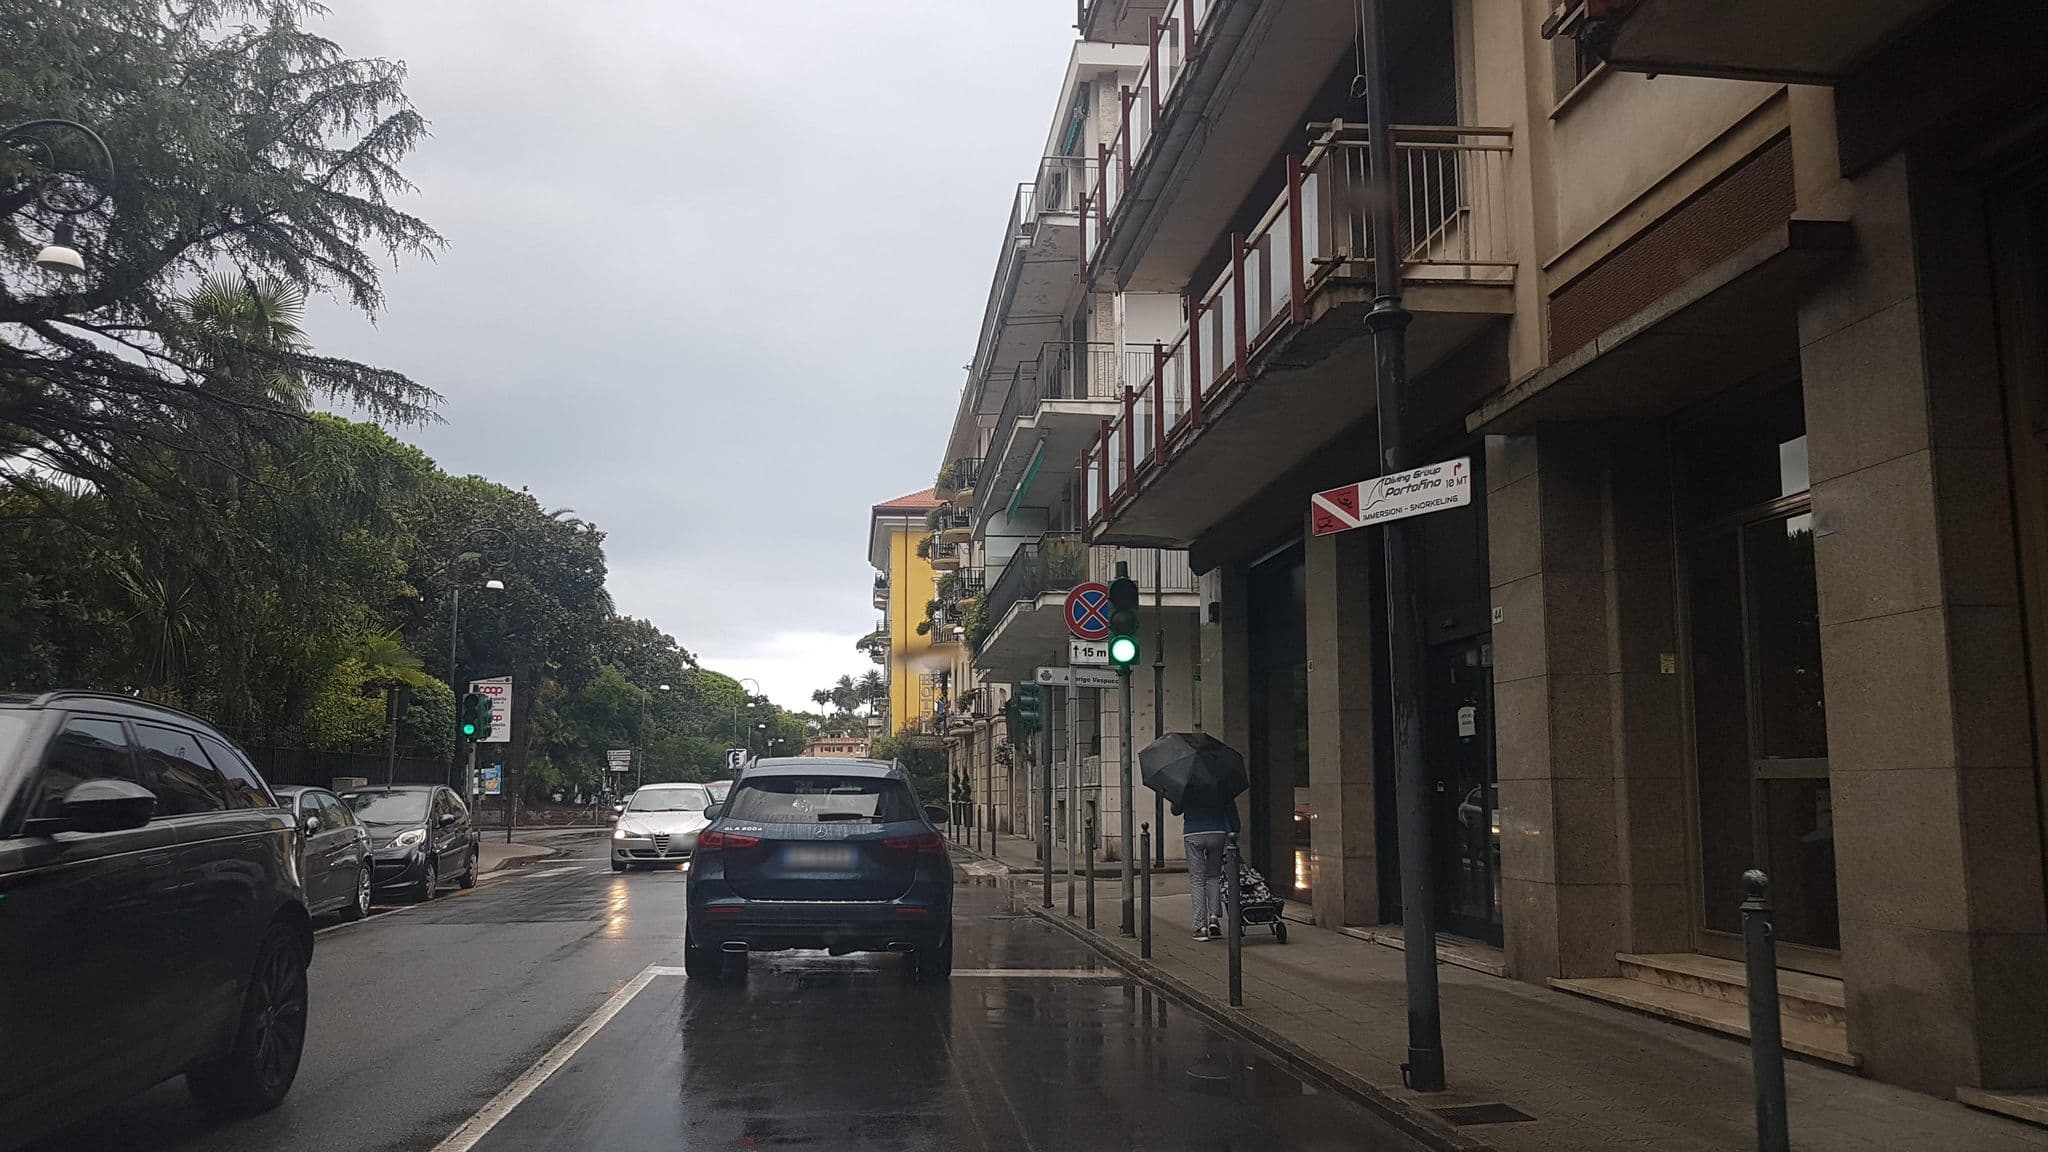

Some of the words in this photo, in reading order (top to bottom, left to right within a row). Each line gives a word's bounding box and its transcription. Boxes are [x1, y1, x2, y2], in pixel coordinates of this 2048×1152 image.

[1384, 475, 1411, 485] Diving
[1413, 467, 1441, 479] Group
[1456, 475, 1468, 487] MT
[1385, 479, 1441, 498] Portofino
[1363, 507, 1402, 521] IMMERSIONI
[1410, 495, 1459, 511] SNORKELING
[1082, 647, 1094, 657] 15
[479, 686, 503, 696] coop
